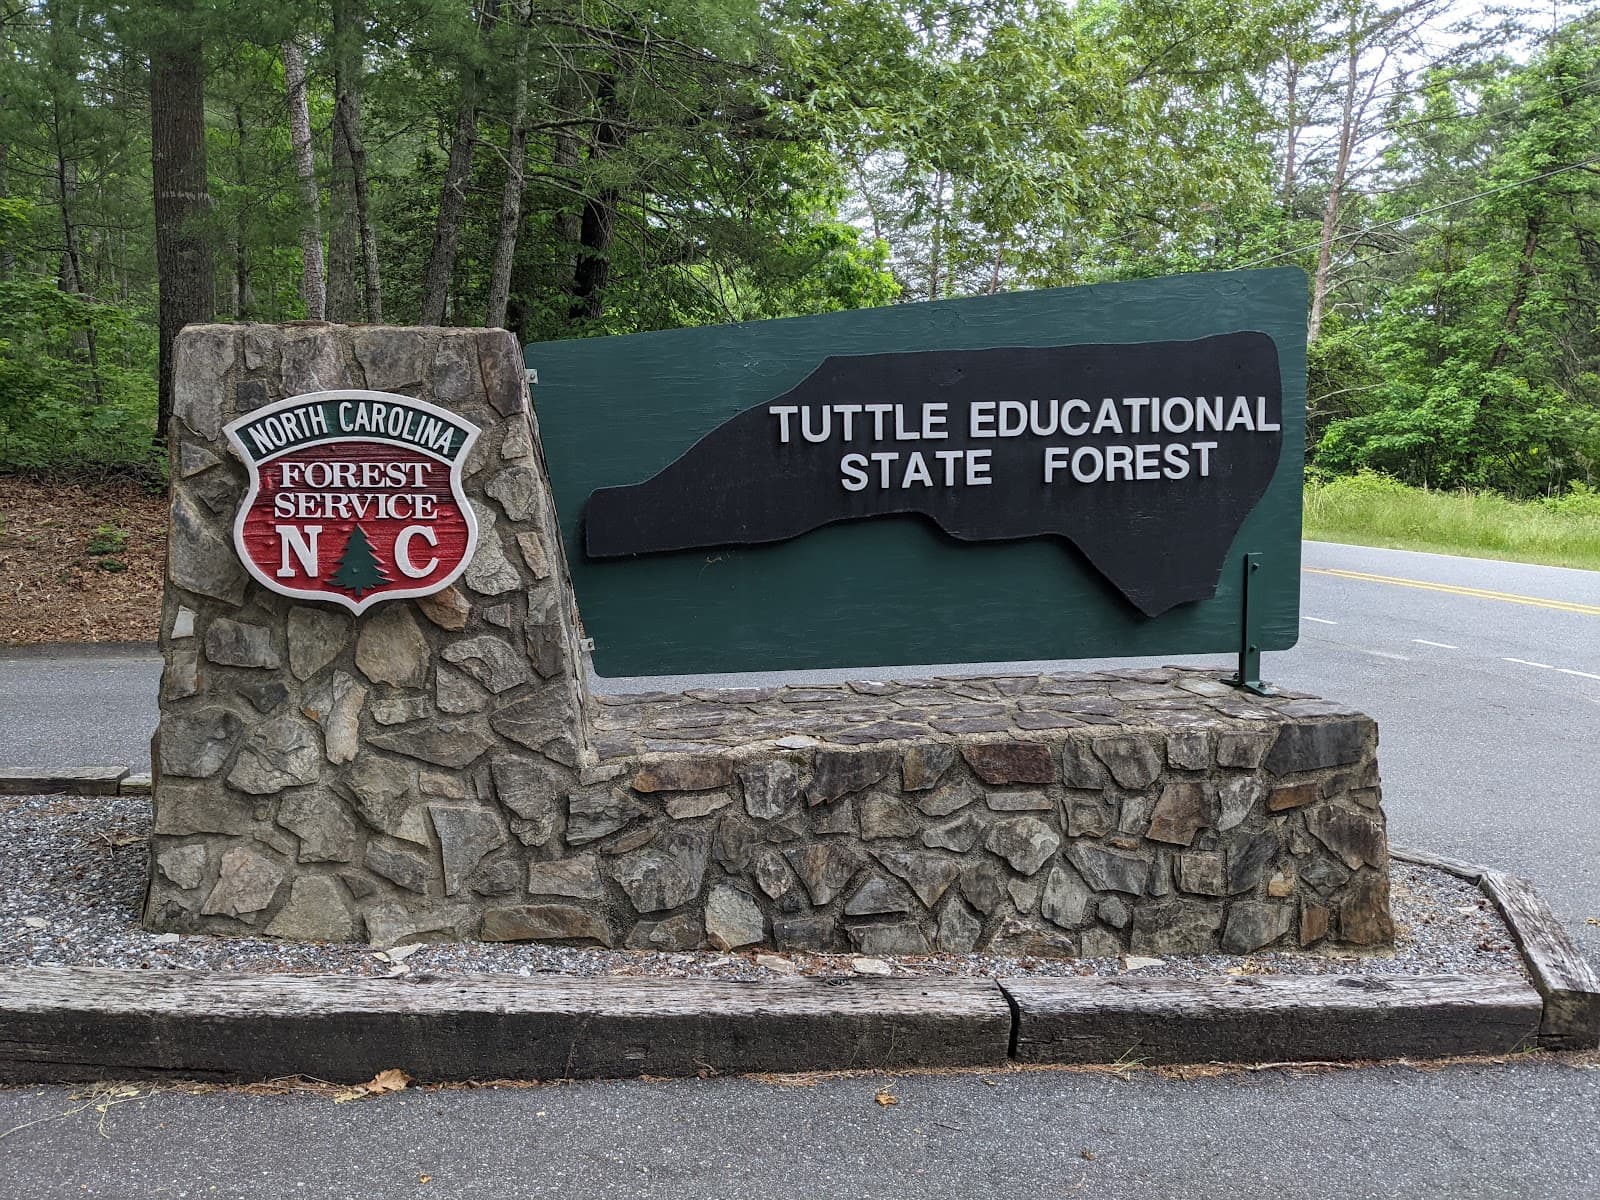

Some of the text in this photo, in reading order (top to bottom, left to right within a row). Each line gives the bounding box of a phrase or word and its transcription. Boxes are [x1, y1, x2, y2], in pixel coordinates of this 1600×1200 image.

[248, 402, 455, 455] NORTH CAROLINA
[769, 396, 1281, 443] TUTTLE EDUCATIONAL
[279, 462, 431, 488] FOREST
[840, 442, 1218, 492] STATE FOREST
[274, 493, 438, 519] SERVICE
[275, 524, 439, 578] N C
